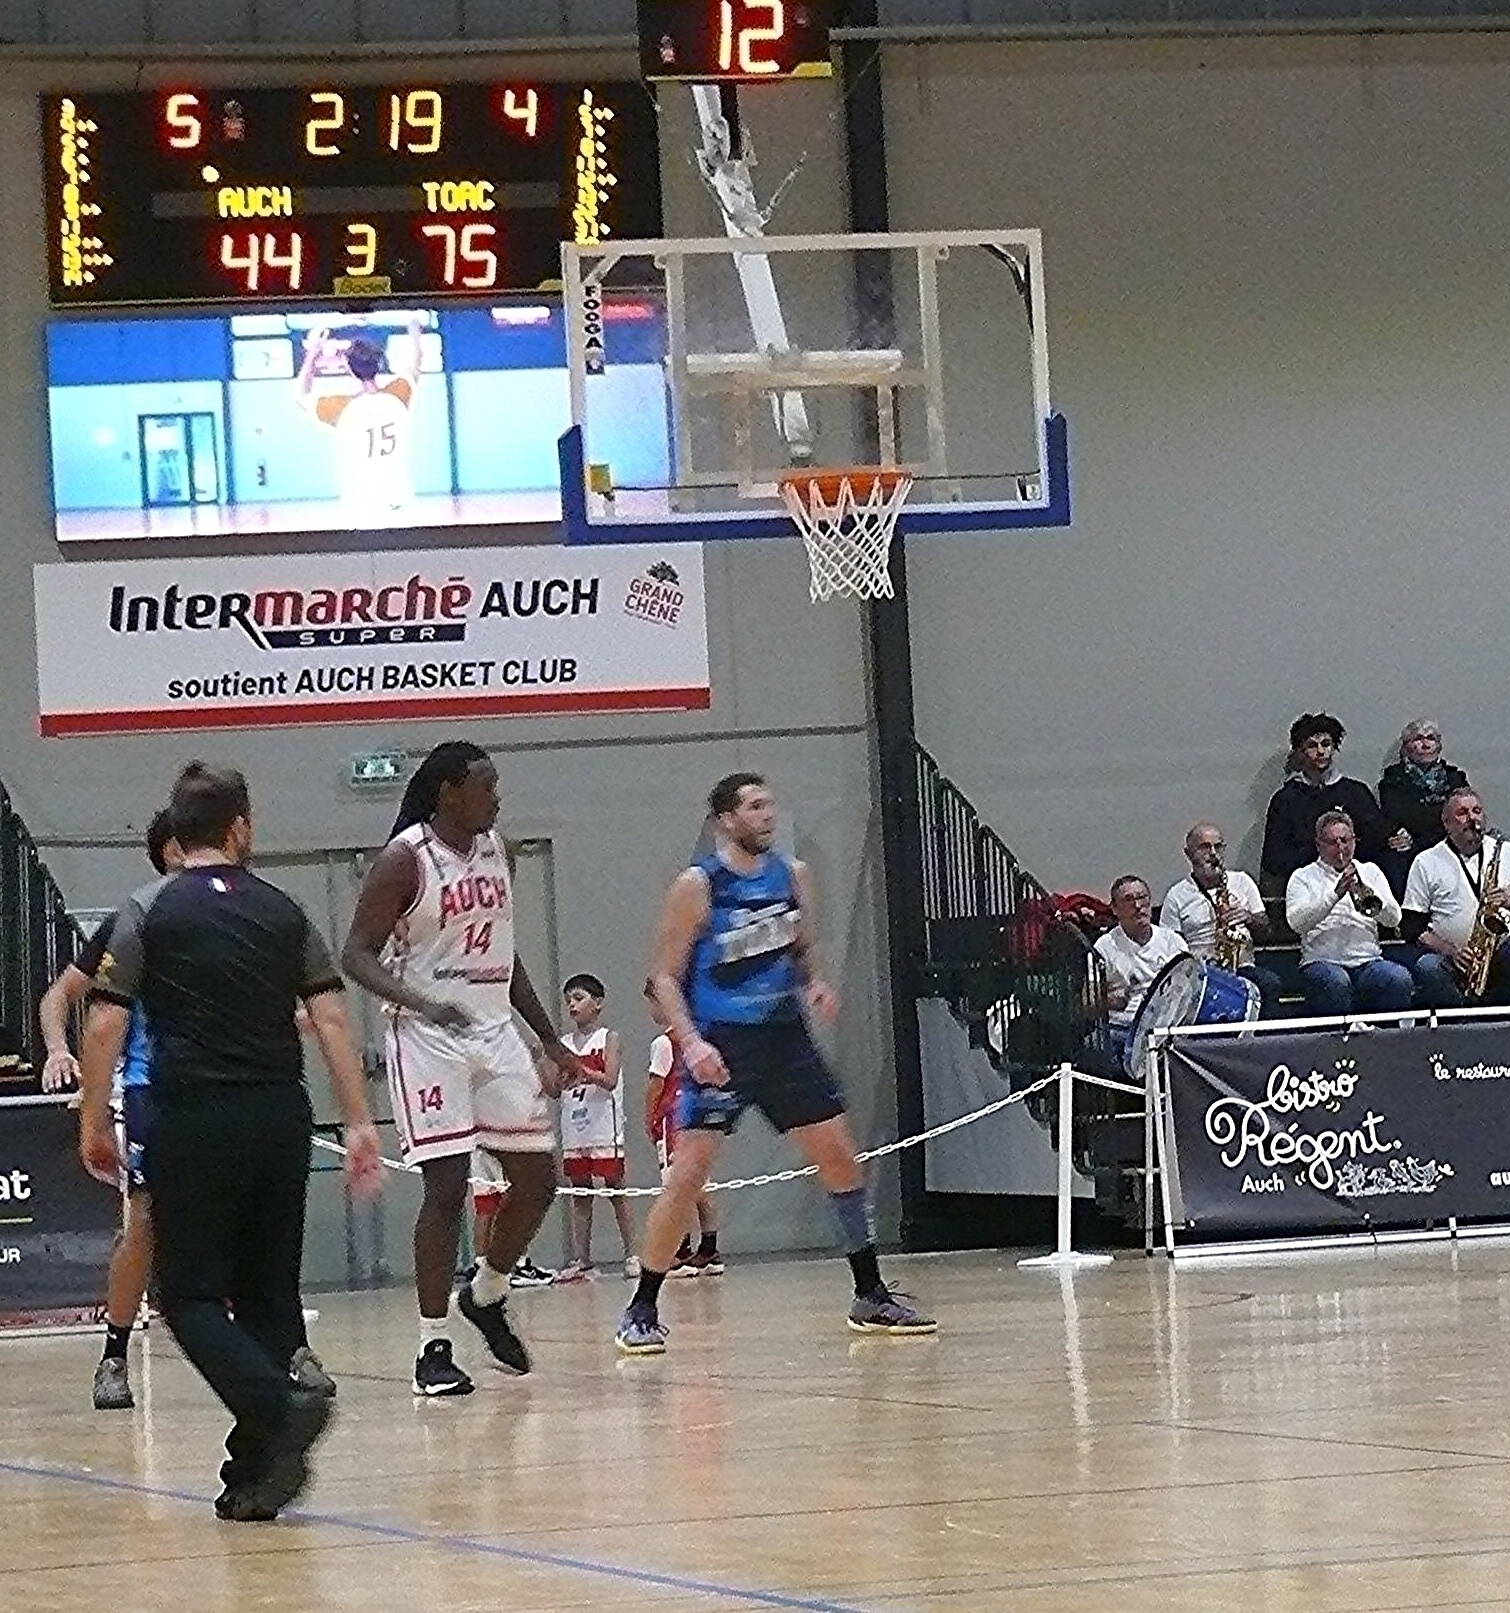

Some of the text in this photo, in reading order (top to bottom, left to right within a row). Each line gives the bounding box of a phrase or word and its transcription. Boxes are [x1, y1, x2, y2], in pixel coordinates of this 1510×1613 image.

[720, 0, 784, 73] 12
[166, 93, 202, 149] 5
[503, 88, 538, 137] 4
[217, 185, 293, 218] AUCH
[421, 180, 496, 213] TOAC
[220, 232, 302, 291] 44
[345, 223, 377, 276] 3
[421, 223, 498, 288] 75
[366, 421, 396, 458] 15
[479, 577, 600, 619] AUCH
[629, 578, 684, 607] GRAND
[168, 658, 577, 700] soutient AUCH BASKET CLUB
[462, 921, 493, 956] 14
[1266, 1064, 1359, 1113] bistro
[1434, 1062, 1451, 1080] le
[417, 1084, 444, 1114] 14
[1241, 1172, 1285, 1194] Auch
